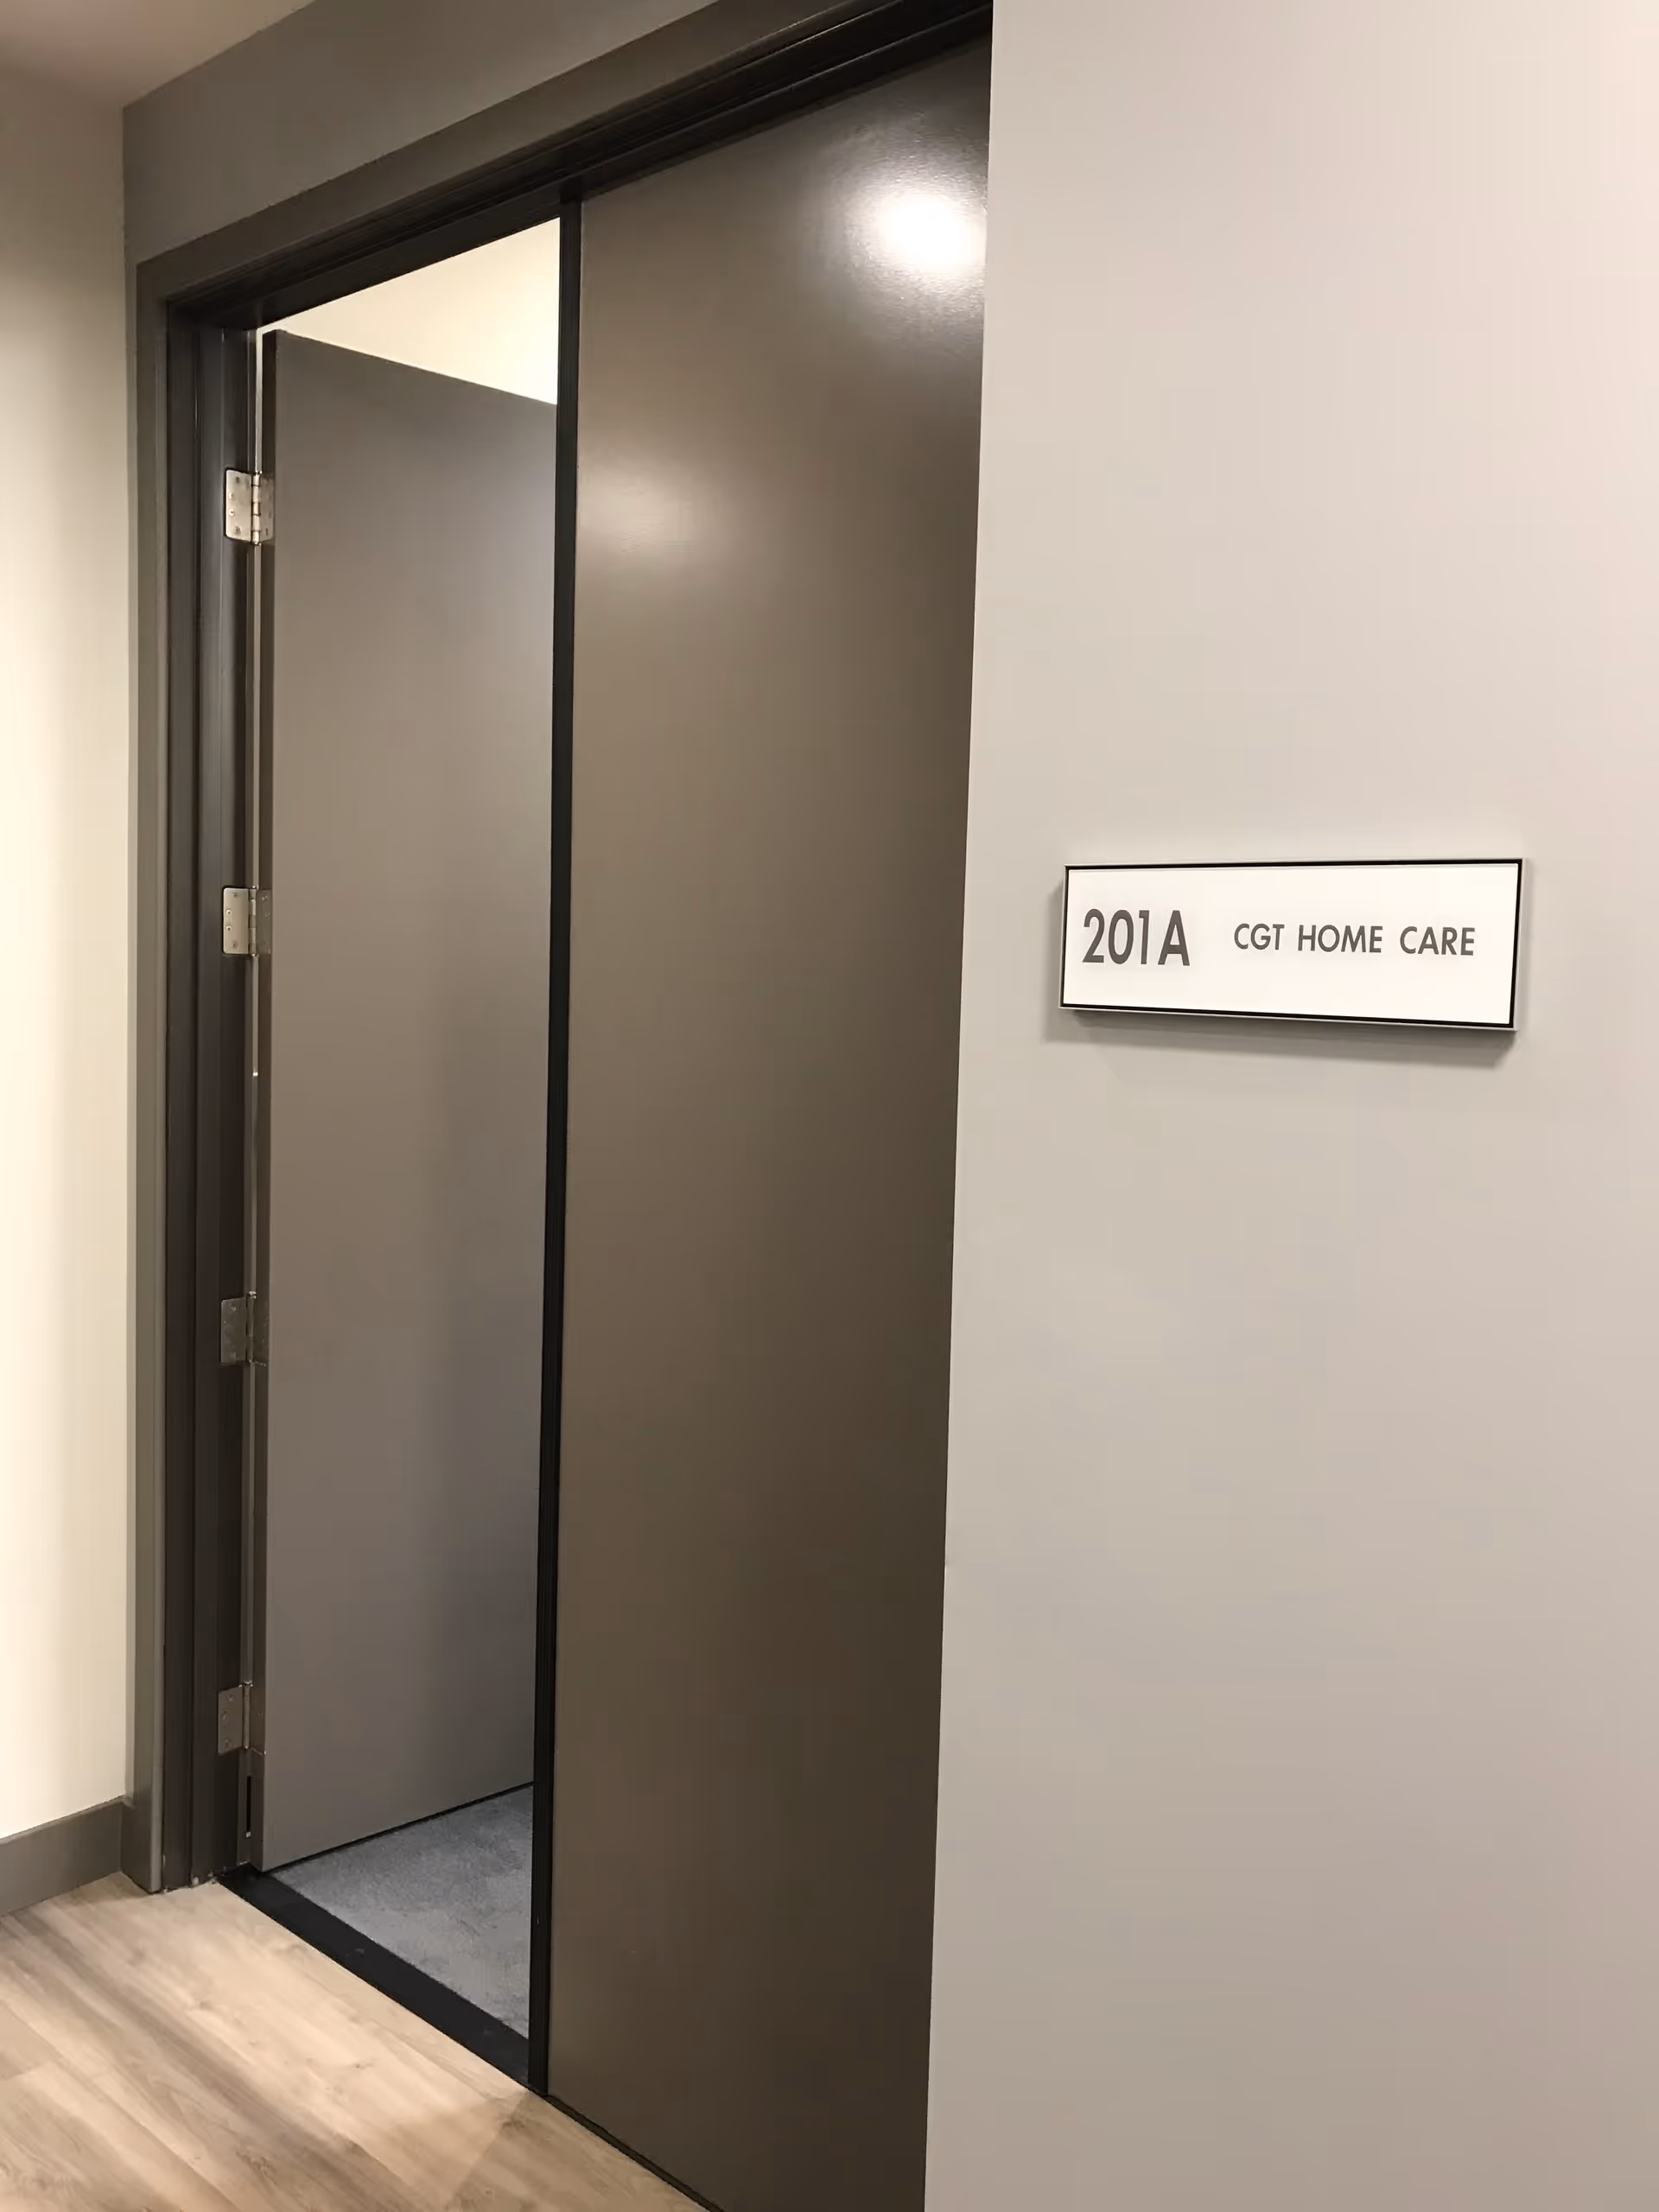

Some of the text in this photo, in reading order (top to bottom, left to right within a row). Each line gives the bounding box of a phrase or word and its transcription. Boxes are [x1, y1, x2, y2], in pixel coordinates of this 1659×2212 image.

[1082, 908, 1475, 967] 201A CGT HOME CARE
